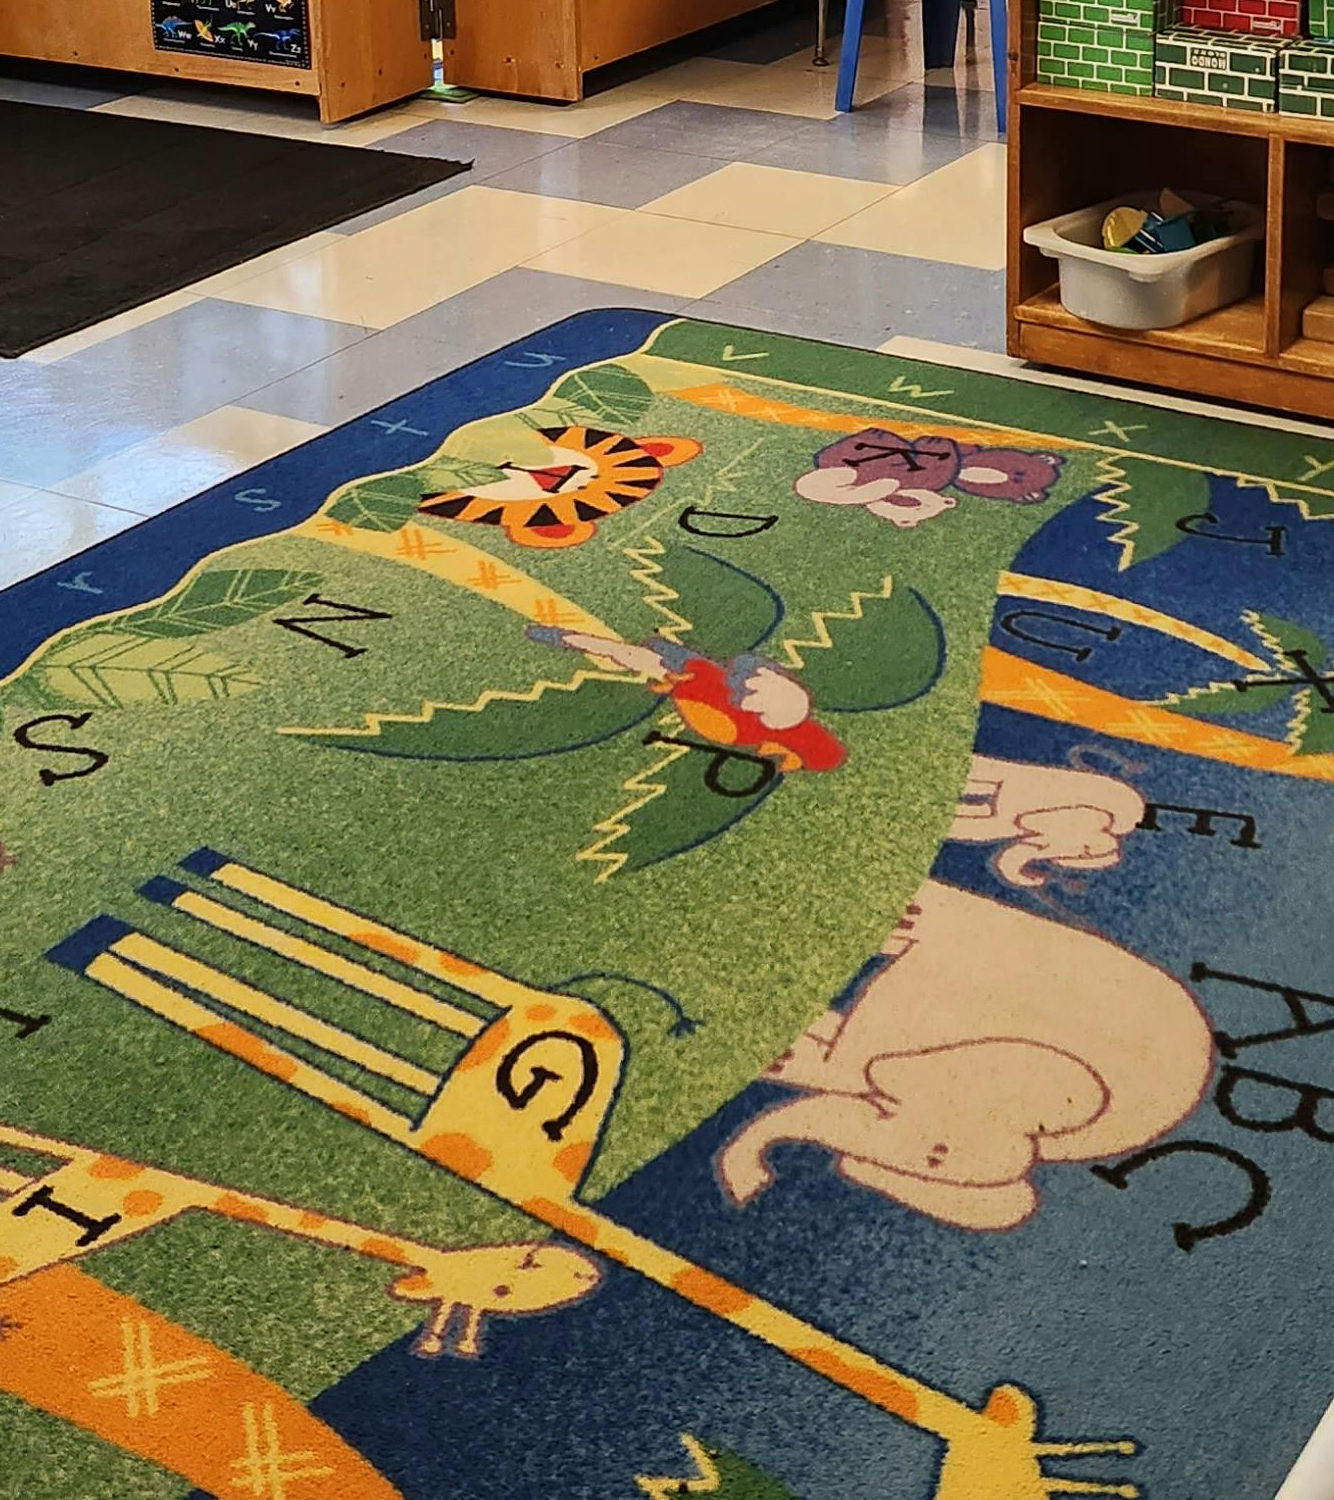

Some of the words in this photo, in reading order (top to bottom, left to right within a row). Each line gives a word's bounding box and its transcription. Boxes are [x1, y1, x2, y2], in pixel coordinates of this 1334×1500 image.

[842, 439, 952, 472] K
[678, 505, 779, 538] D
[1174, 511, 1285, 556] J
[273, 592, 396, 660] N
[1000, 610, 1122, 662] U
[13, 712, 110, 787] S
[642, 730, 780, 797] P
[1135, 803, 1263, 849] E
[497, 1031, 598, 1142] G
[12, 1185, 122, 1248] I
